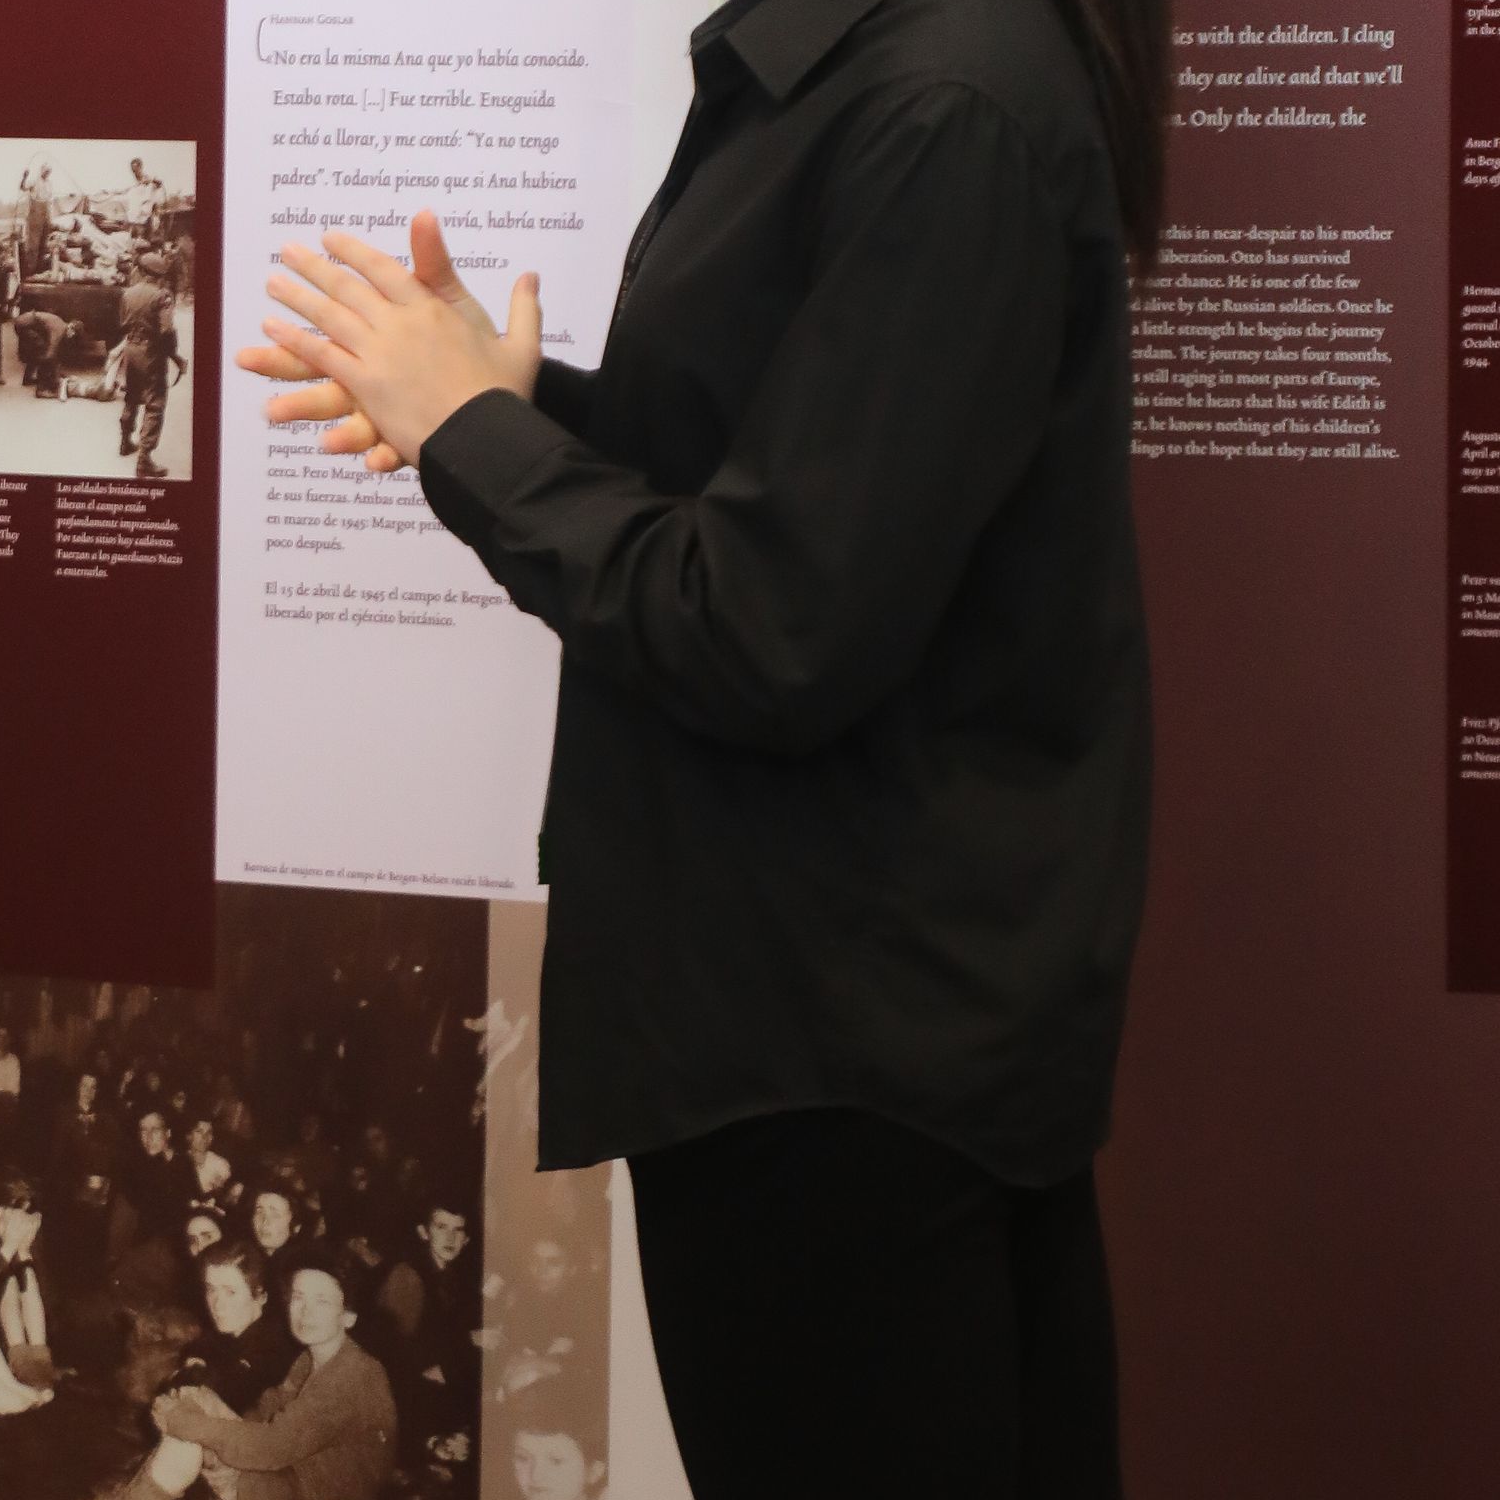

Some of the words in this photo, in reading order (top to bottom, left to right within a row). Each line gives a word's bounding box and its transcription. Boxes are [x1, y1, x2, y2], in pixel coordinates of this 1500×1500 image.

[1196, 24, 1234, 44] with
[1237, 24, 1264, 44] the
[1266, 24, 1338, 44] children.
[1341, 26, 1350, 44] I
[1351, 23, 1394, 49] cling
[299, 53, 320, 65] era
[325, 48, 338, 65] la
[343, 48, 391, 66] misma
[393, 50, 423, 66] Ana
[427, 54, 452, 72] que
[453, 54, 473, 72] yo
[477, 50, 519, 67] había
[1178, 65, 1213, 92] they
[1215, 72, 1242, 85] are
[1244, 65, 1286, 85] alive
[1287, 65, 1321, 85] and
[1323, 65, 1361, 85] that
[1363, 64, 1403, 85] we’ll
[1189, 106, 1232, 132] Only
[1234, 106, 1262, 126] the
[1264, 106, 1336, 128] children,
[1338, 105, 1366, 126] the
